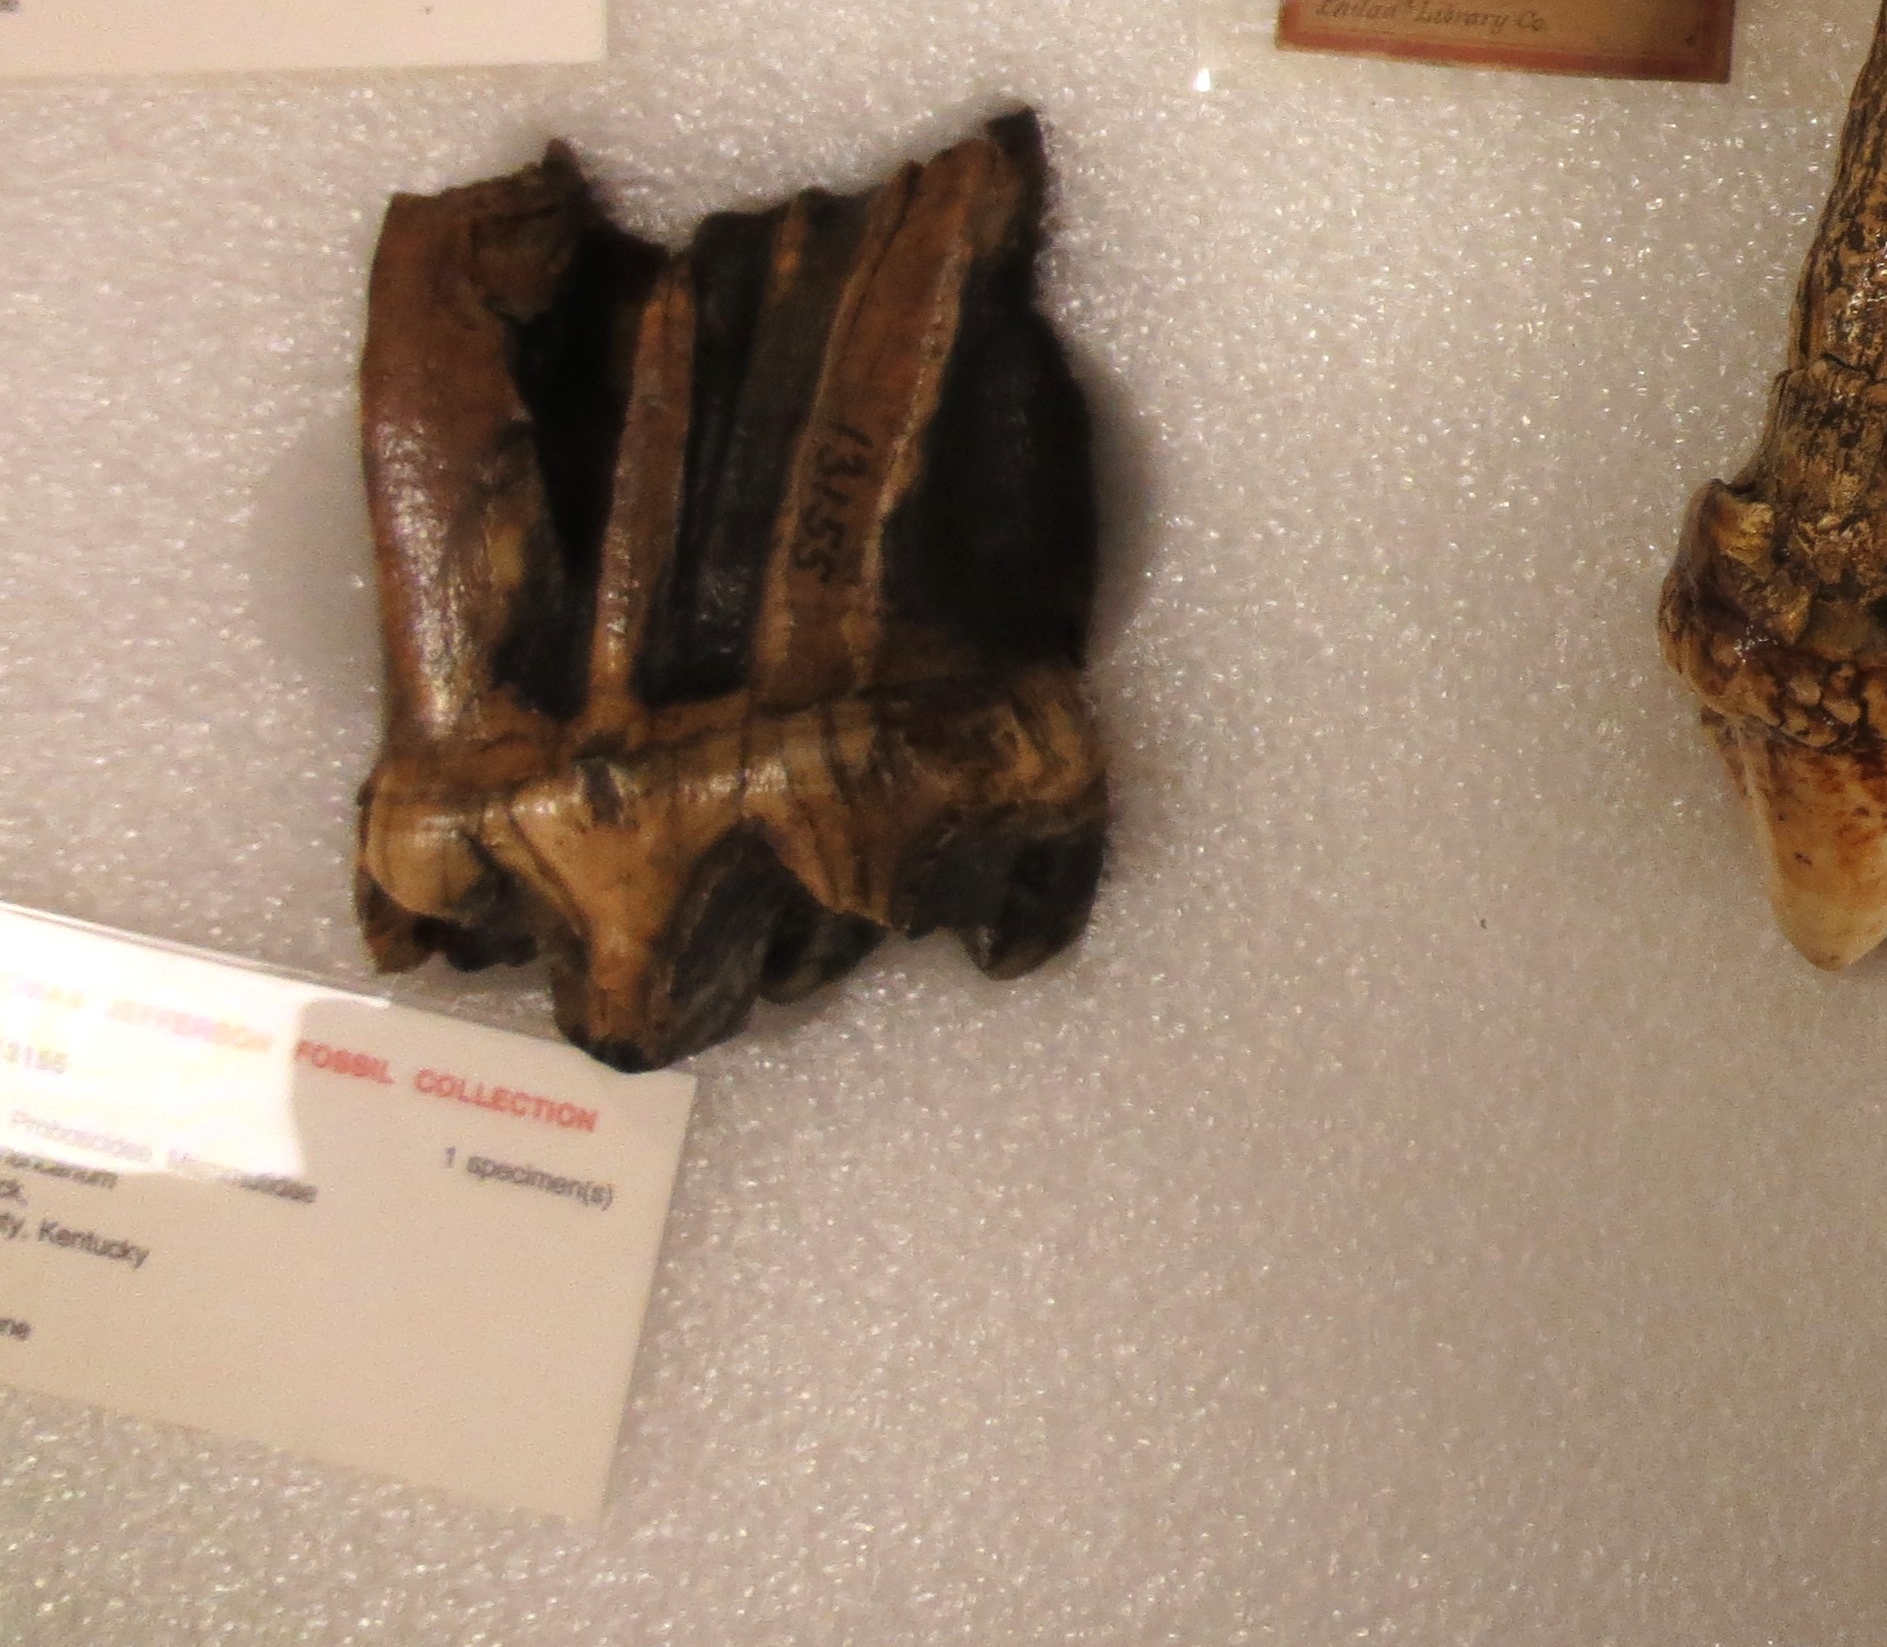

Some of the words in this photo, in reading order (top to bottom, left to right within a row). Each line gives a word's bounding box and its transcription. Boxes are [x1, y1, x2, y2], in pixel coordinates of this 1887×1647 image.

[295, 1039, 395, 1085] FOSSIL
[412, 1067, 599, 1132] COLLECTION
[446, 1146, 456, 1169] 1
[467, 1155, 614, 1210] specimen(s)
[37, 1218, 150, 1269] Kentucky
